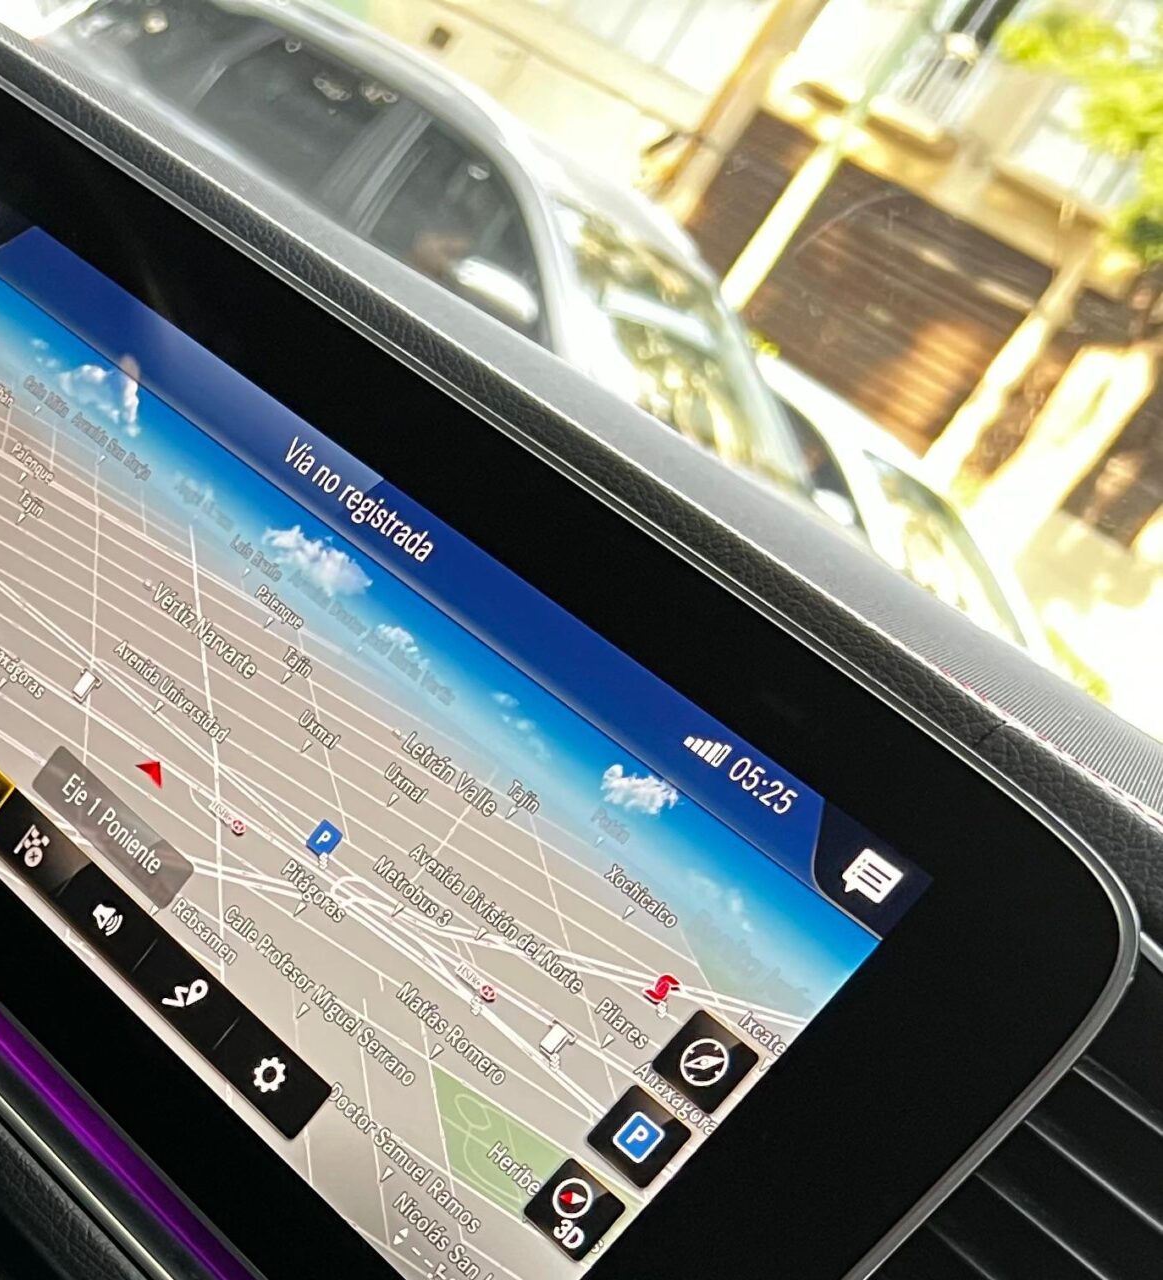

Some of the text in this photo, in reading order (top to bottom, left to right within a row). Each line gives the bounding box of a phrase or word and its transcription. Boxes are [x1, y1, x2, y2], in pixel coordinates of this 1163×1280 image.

[10, 442, 54, 484] Palenque
[279, 434, 435, 563] Vía no registrada
[149, 581, 258, 681] Vértiz Narvarte
[253, 583, 304, 630] Palenque
[112, 637, 231, 744] Avenida Universidad
[281, 645, 313, 677] Tajín
[296, 709, 340, 751] Uxmal
[382, 762, 428, 805] Uxmal
[401, 731, 498, 819] Letrán Valle
[506, 779, 541, 813] Tajín
[725, 755, 799, 816] 05:25
[61, 772, 162, 876] Eje 1 Poniente
[280, 857, 347, 923] Pitágoras
[372, 854, 454, 929] Metrobus 3
[408, 841, 583, 996] Avenida División del Norte
[604, 864, 677, 929] Xochicalco
[170, 896, 237, 966] Rébsamen
[222, 902, 416, 1088] Calle Profesor Miguel Serrano
[593, 996, 649, 1050] Pilares
[395, 981, 506, 1087] Matías Romero
[325, 1081, 481, 1236] Doctor Samuel Ramos
[391, 1189, 451, 1253] Nicolás
[549, 1214, 588, 1254] 3D
